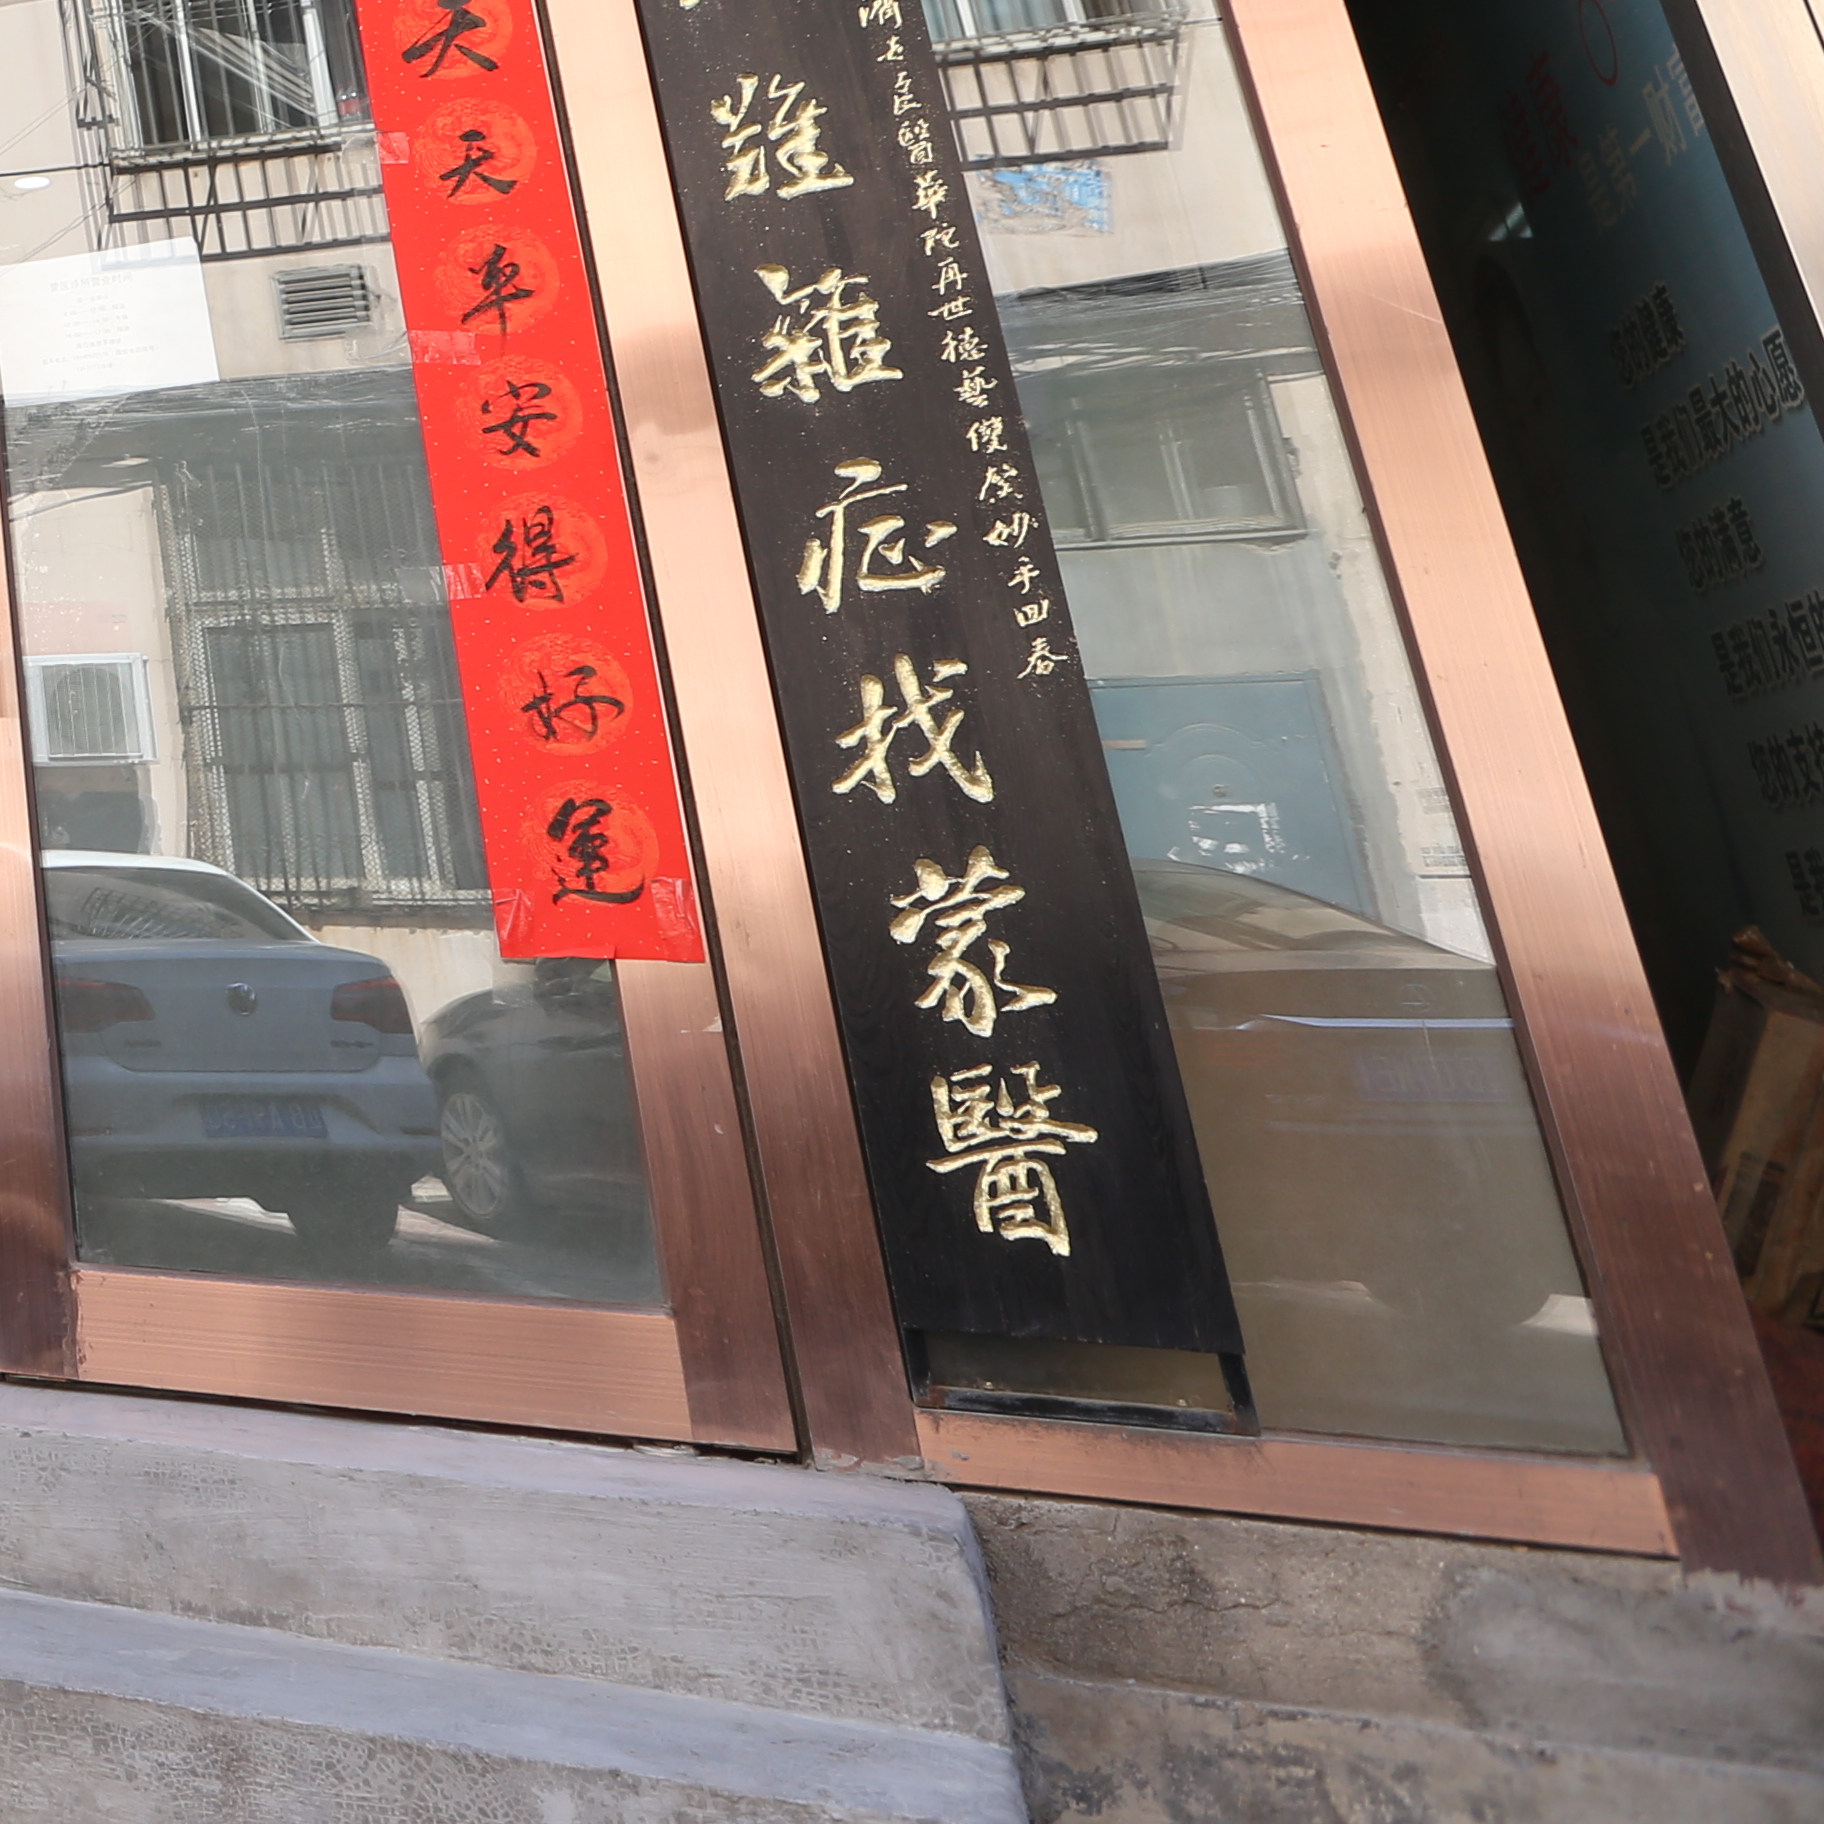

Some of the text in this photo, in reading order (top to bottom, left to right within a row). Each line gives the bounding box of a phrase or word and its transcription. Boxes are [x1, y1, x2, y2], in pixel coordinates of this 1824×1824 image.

[1639, 329, 1805, 492] 是我们最大的心愿
[1675, 495, 1765, 592] 您的满意
